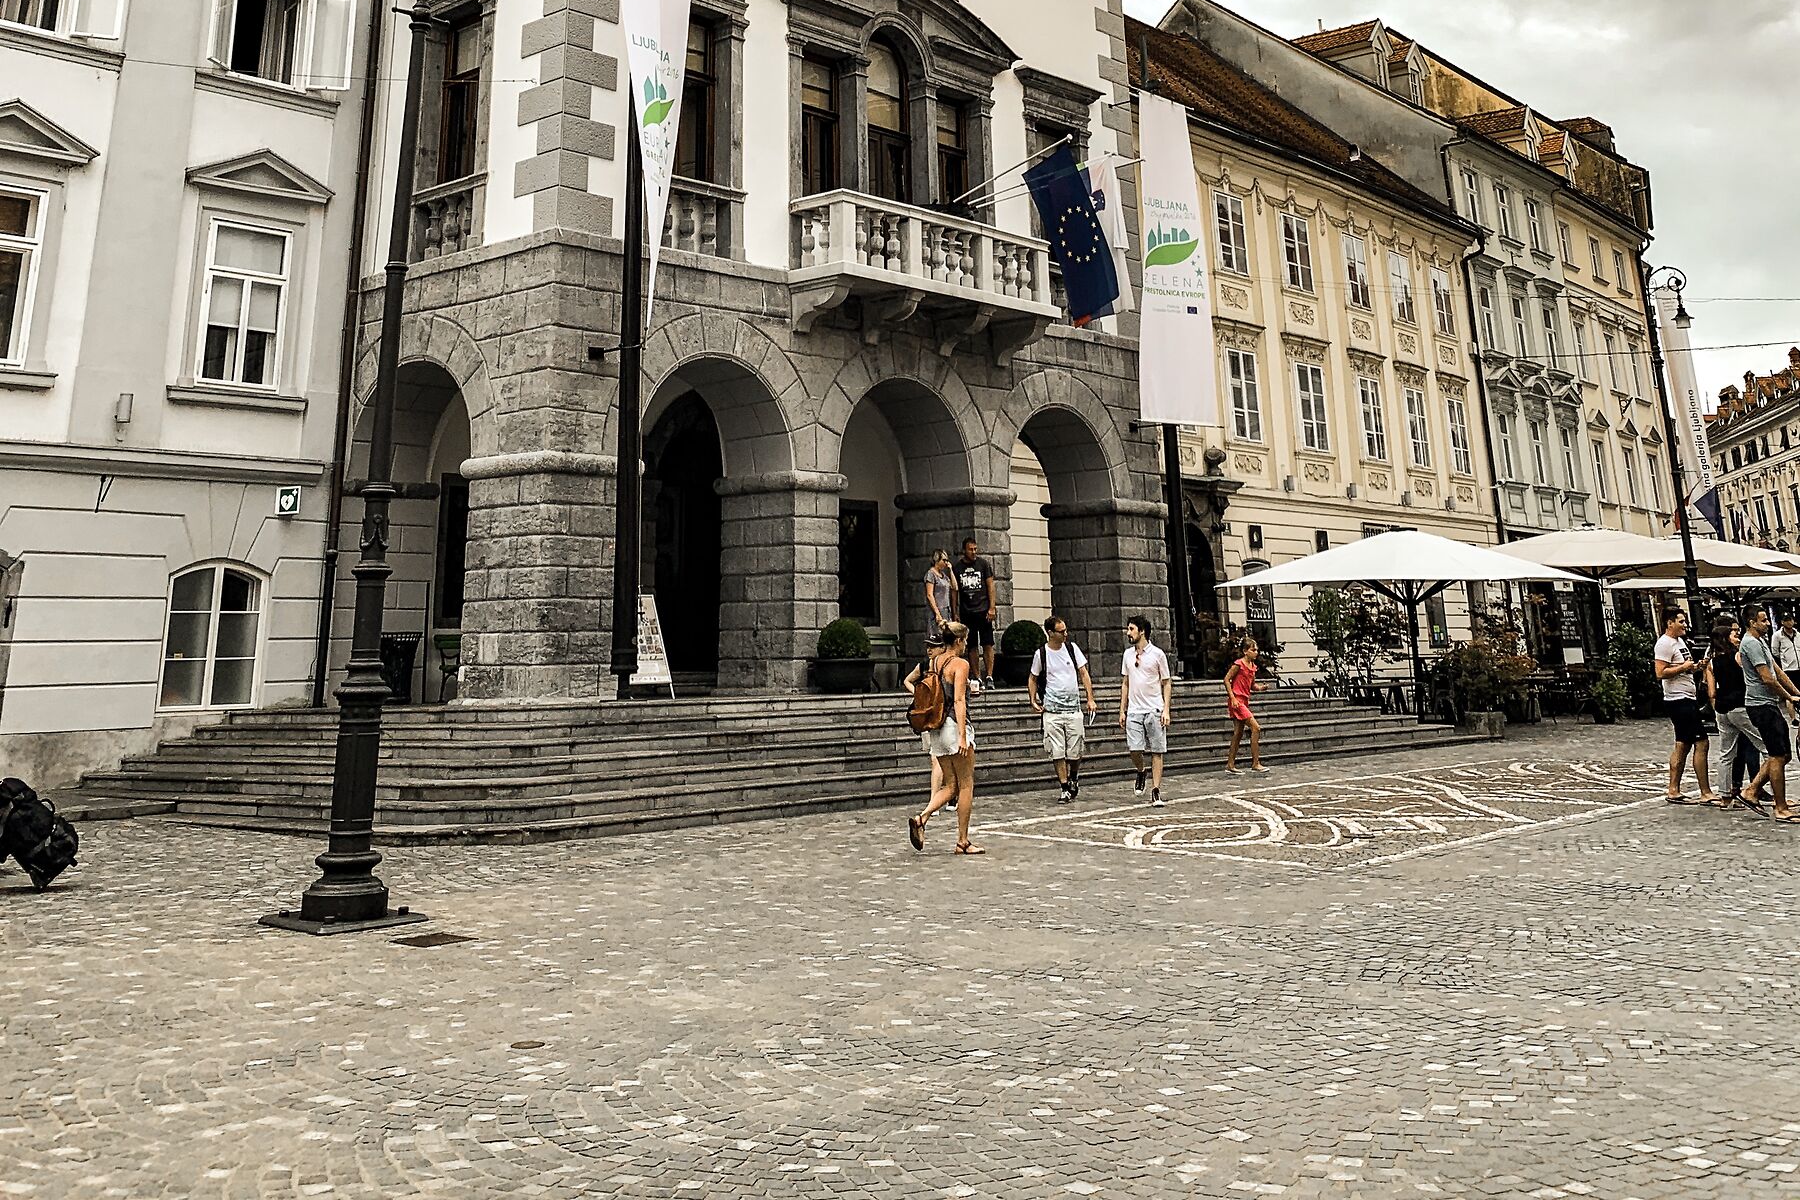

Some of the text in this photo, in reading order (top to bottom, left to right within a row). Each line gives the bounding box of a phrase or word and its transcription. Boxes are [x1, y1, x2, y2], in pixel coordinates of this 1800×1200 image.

[1144, 197, 1189, 212] LJUBLJANA
[1144, 272, 1204, 289] ZELENA
[1144, 286, 1206, 299] PRESTOLNICA EVROPE
[1688, 389, 1703, 432] Ljubljana
[1694, 435, 1710, 470] galerija
